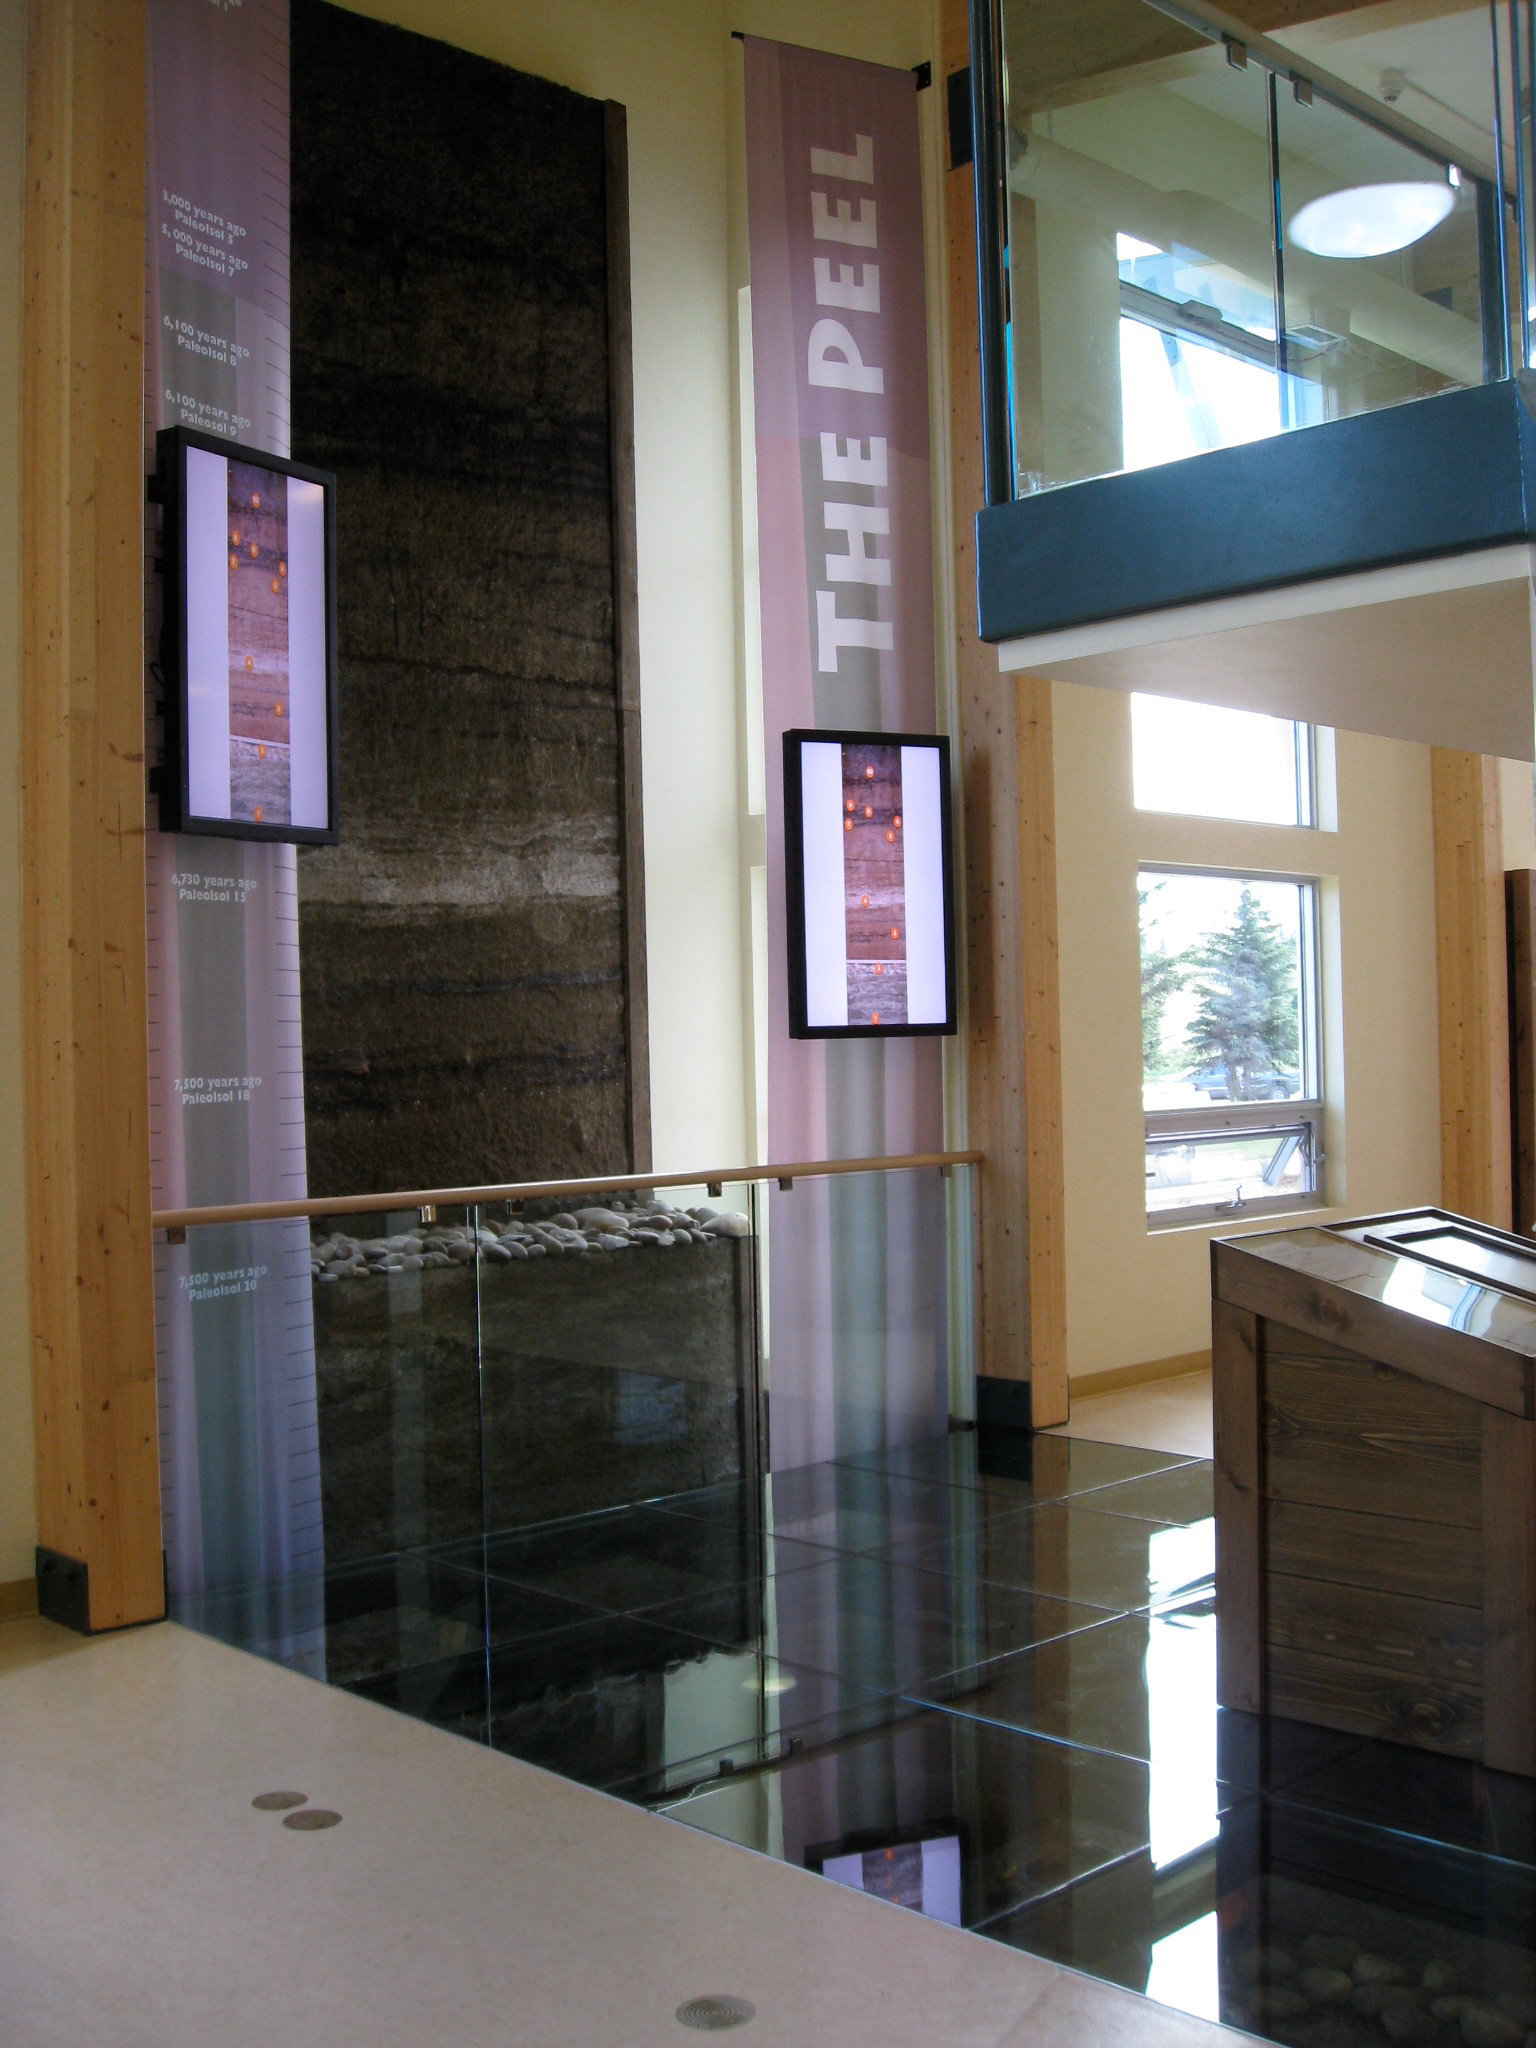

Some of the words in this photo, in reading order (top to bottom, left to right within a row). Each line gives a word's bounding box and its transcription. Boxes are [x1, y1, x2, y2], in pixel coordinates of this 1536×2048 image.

[194, 206, 224, 227] years
[227, 222, 247, 237] ago
[228, 234, 234, 245] 5
[196, 241, 226, 261] years
[229, 255, 249, 271] ago
[807, 133, 884, 395] PEEL
[228, 266, 235, 277] 7
[163, 315, 194, 337] 6,100
[197, 331, 227, 350] years
[230, 343, 250, 359] ago
[165, 389, 196, 409] 6,100
[199, 403, 229, 421] years
[232, 415, 252, 430] ago
[181, 409, 227, 433] Paleosol
[230, 426, 237, 437] 9
[815, 432, 894, 673] THE
[171, 873, 200, 887] 6,730
[204, 876, 235, 889] years
[238, 879, 258, 892] ago
[234, 891, 247, 903] 15
[208, 1077, 239, 1092] years
[242, 1077, 262, 1089] ago
[238, 1089, 250, 1101] 18
[179, 1272, 209, 1289] 7,500
[213, 1268, 245, 1285] years
[247, 1265, 267, 1279] ago
[244, 1279, 257, 1292] 20
